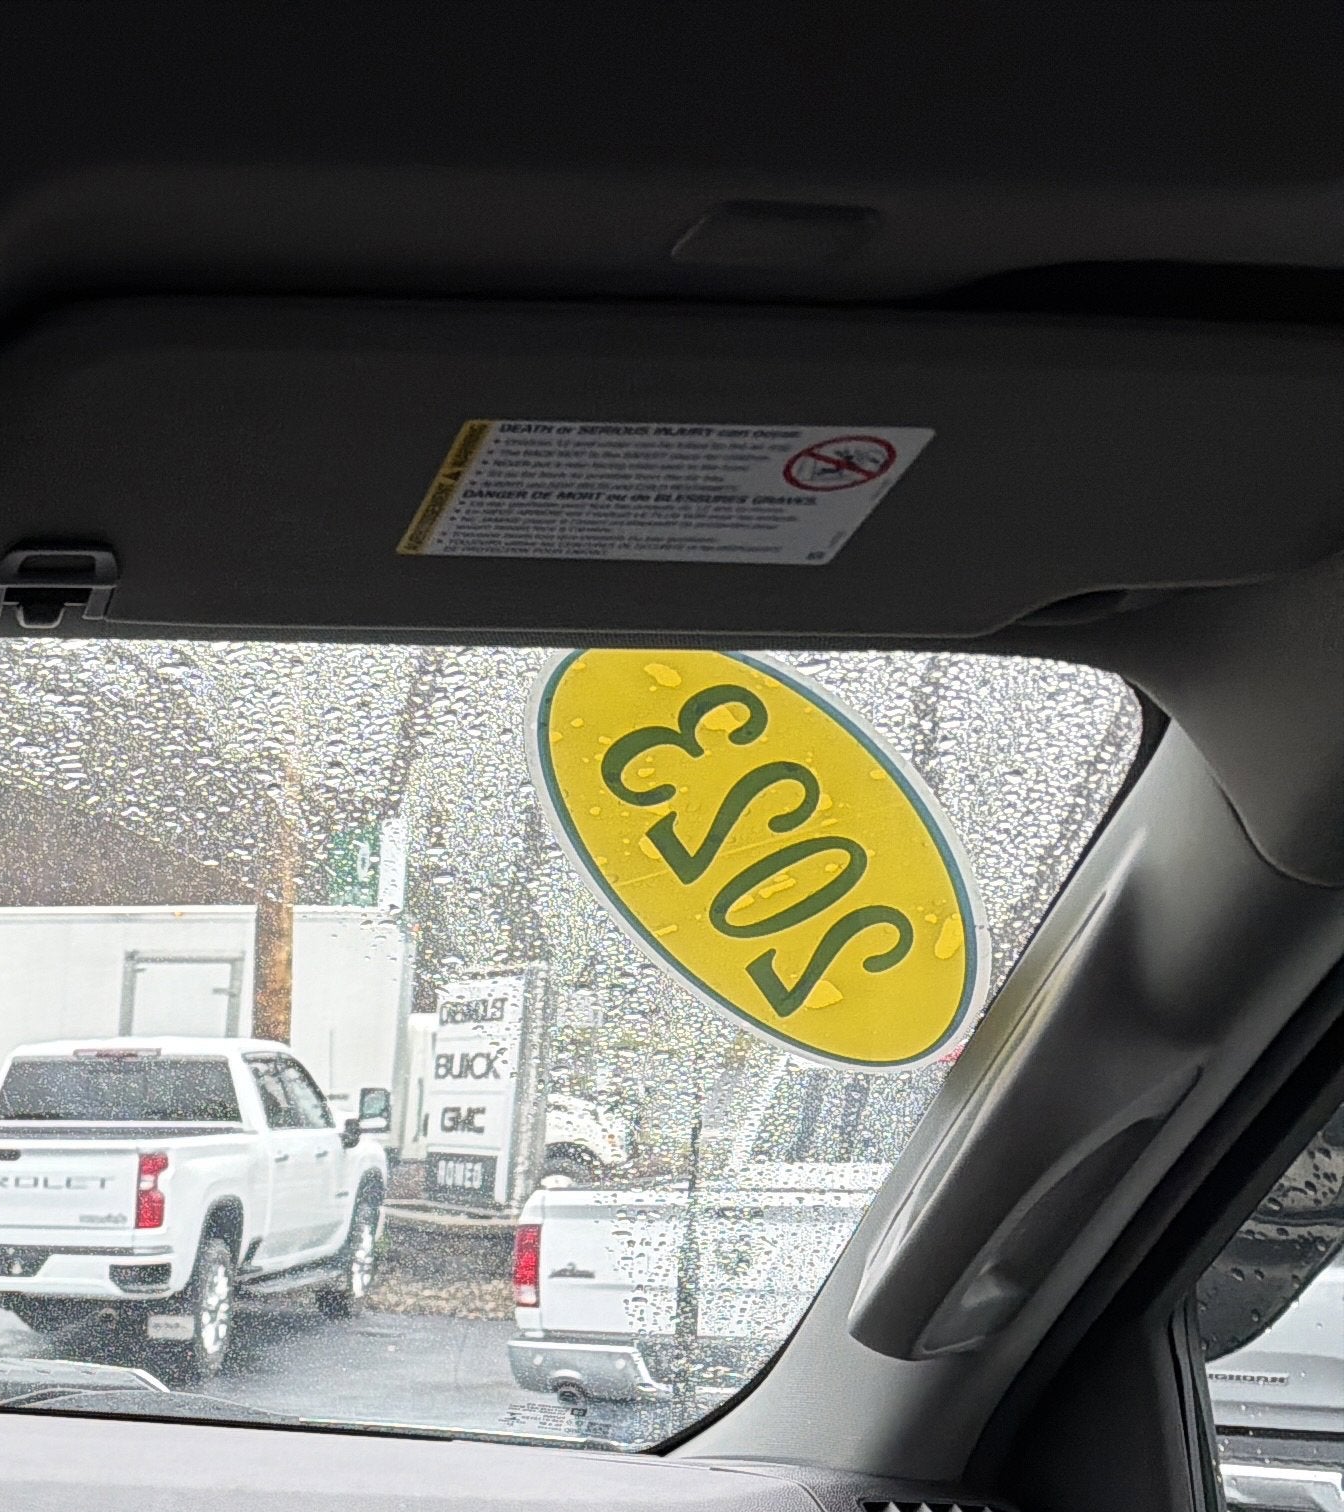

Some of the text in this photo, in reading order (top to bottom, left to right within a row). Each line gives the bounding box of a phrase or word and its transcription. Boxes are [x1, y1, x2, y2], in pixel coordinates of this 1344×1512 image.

[500, 423, 554, 434] DEATH
[434, 1049, 502, 1081] BUICK
[440, 1106, 486, 1134] GMC
